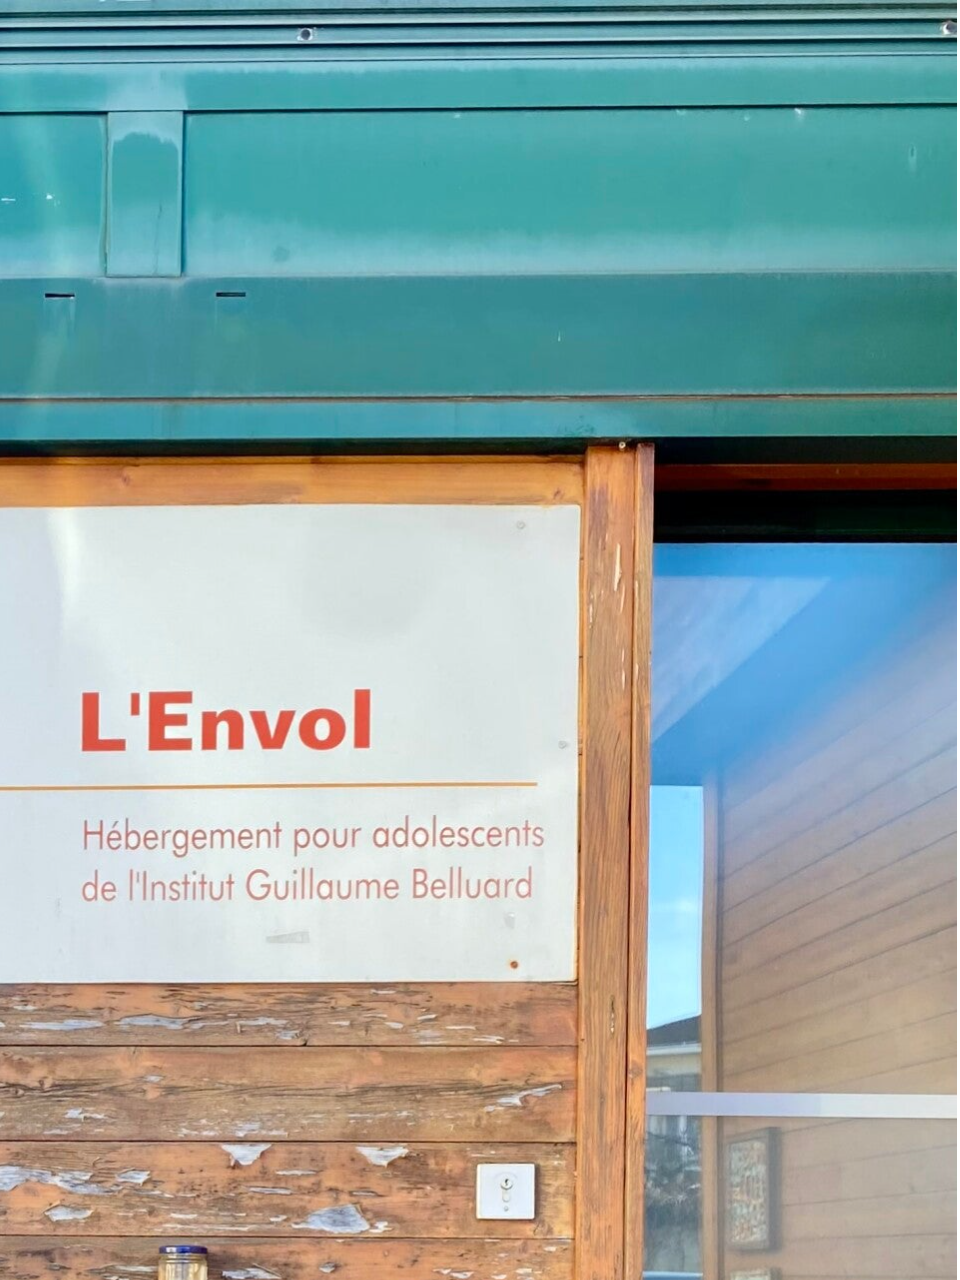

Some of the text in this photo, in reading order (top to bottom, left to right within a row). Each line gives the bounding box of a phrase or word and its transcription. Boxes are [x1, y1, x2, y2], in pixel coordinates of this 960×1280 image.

[81, 688, 371, 752] L'Envol
[82, 815, 545, 858] Hébergement pour adolescents
[81, 866, 534, 903] de l'Institut Guillaume Belluard
